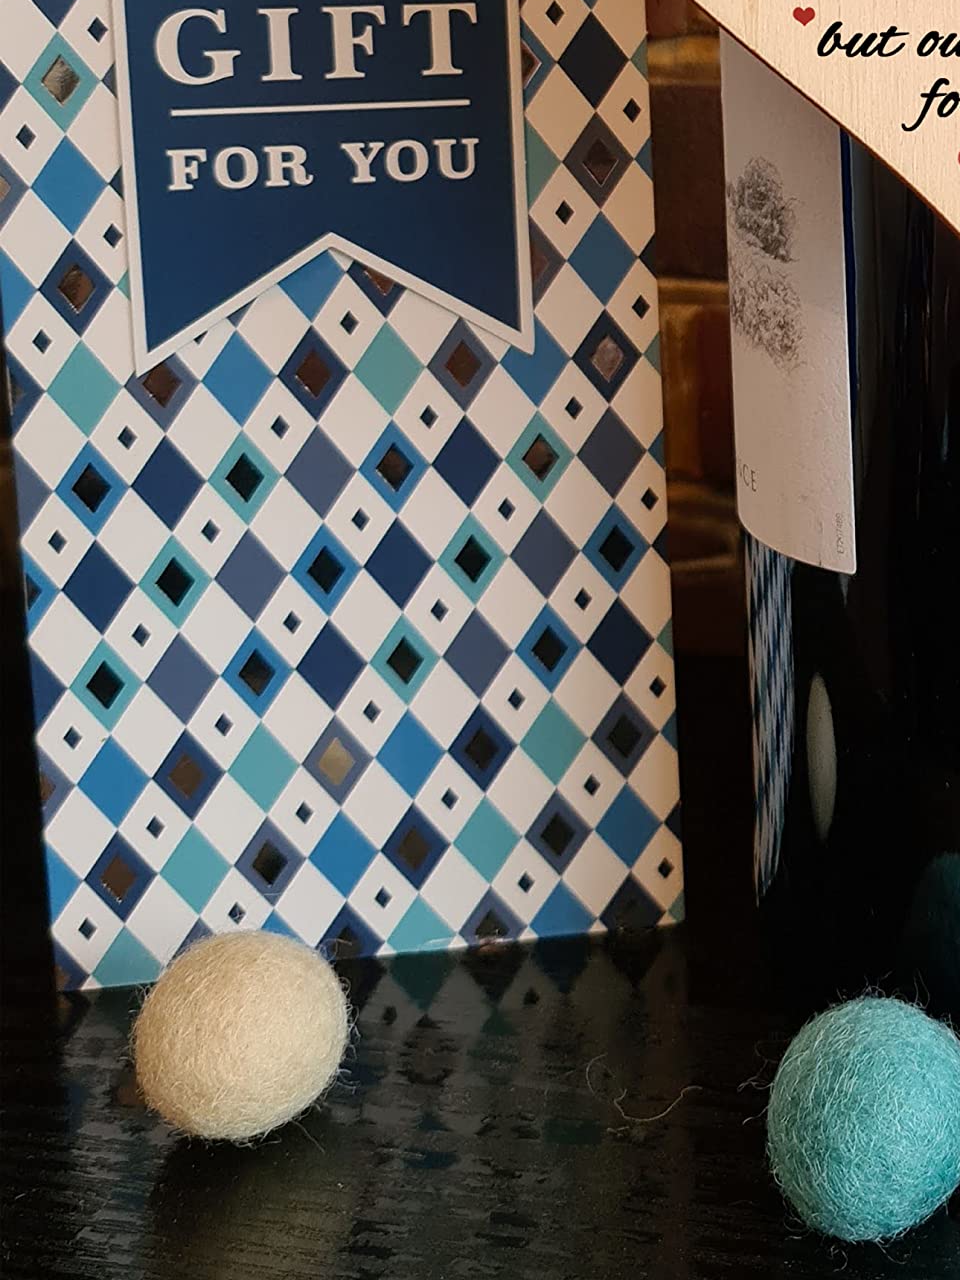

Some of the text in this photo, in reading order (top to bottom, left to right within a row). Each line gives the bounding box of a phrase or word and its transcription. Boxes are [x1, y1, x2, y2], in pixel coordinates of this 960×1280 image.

[154, 2, 478, 85] GIFT
[816, 21, 910, 58] but
[165, 137, 479, 191] FOR YOU
[739, 458, 758, 493] CE
